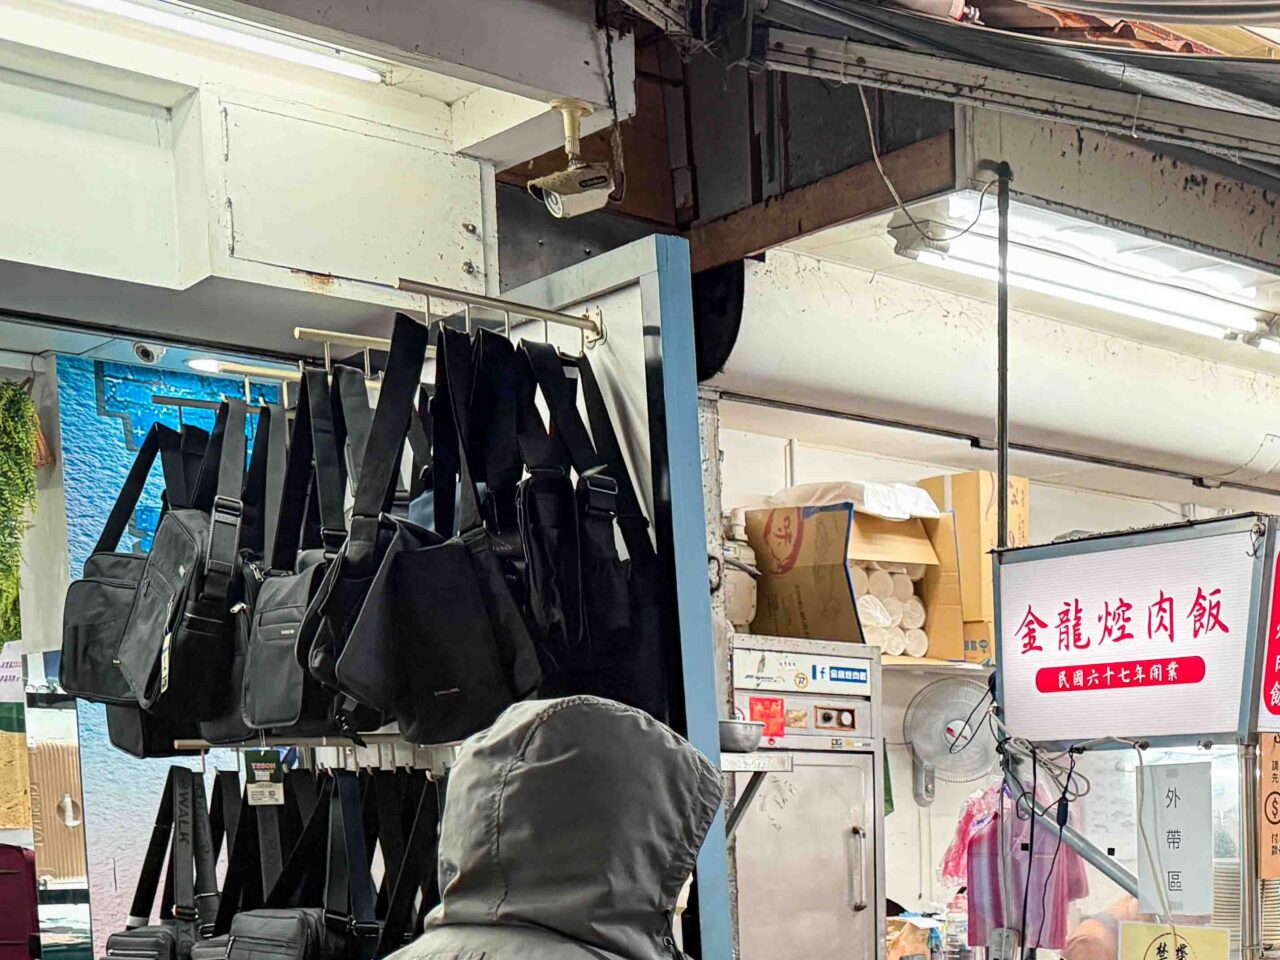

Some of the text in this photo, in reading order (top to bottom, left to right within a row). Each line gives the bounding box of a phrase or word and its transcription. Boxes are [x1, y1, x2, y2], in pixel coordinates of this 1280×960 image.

[1014, 586, 1230, 655] 金龍焢肉飯
[1058, 661, 1180, 689] 民國六十七年開業
[1165, 787, 1184, 892] 外帶區
